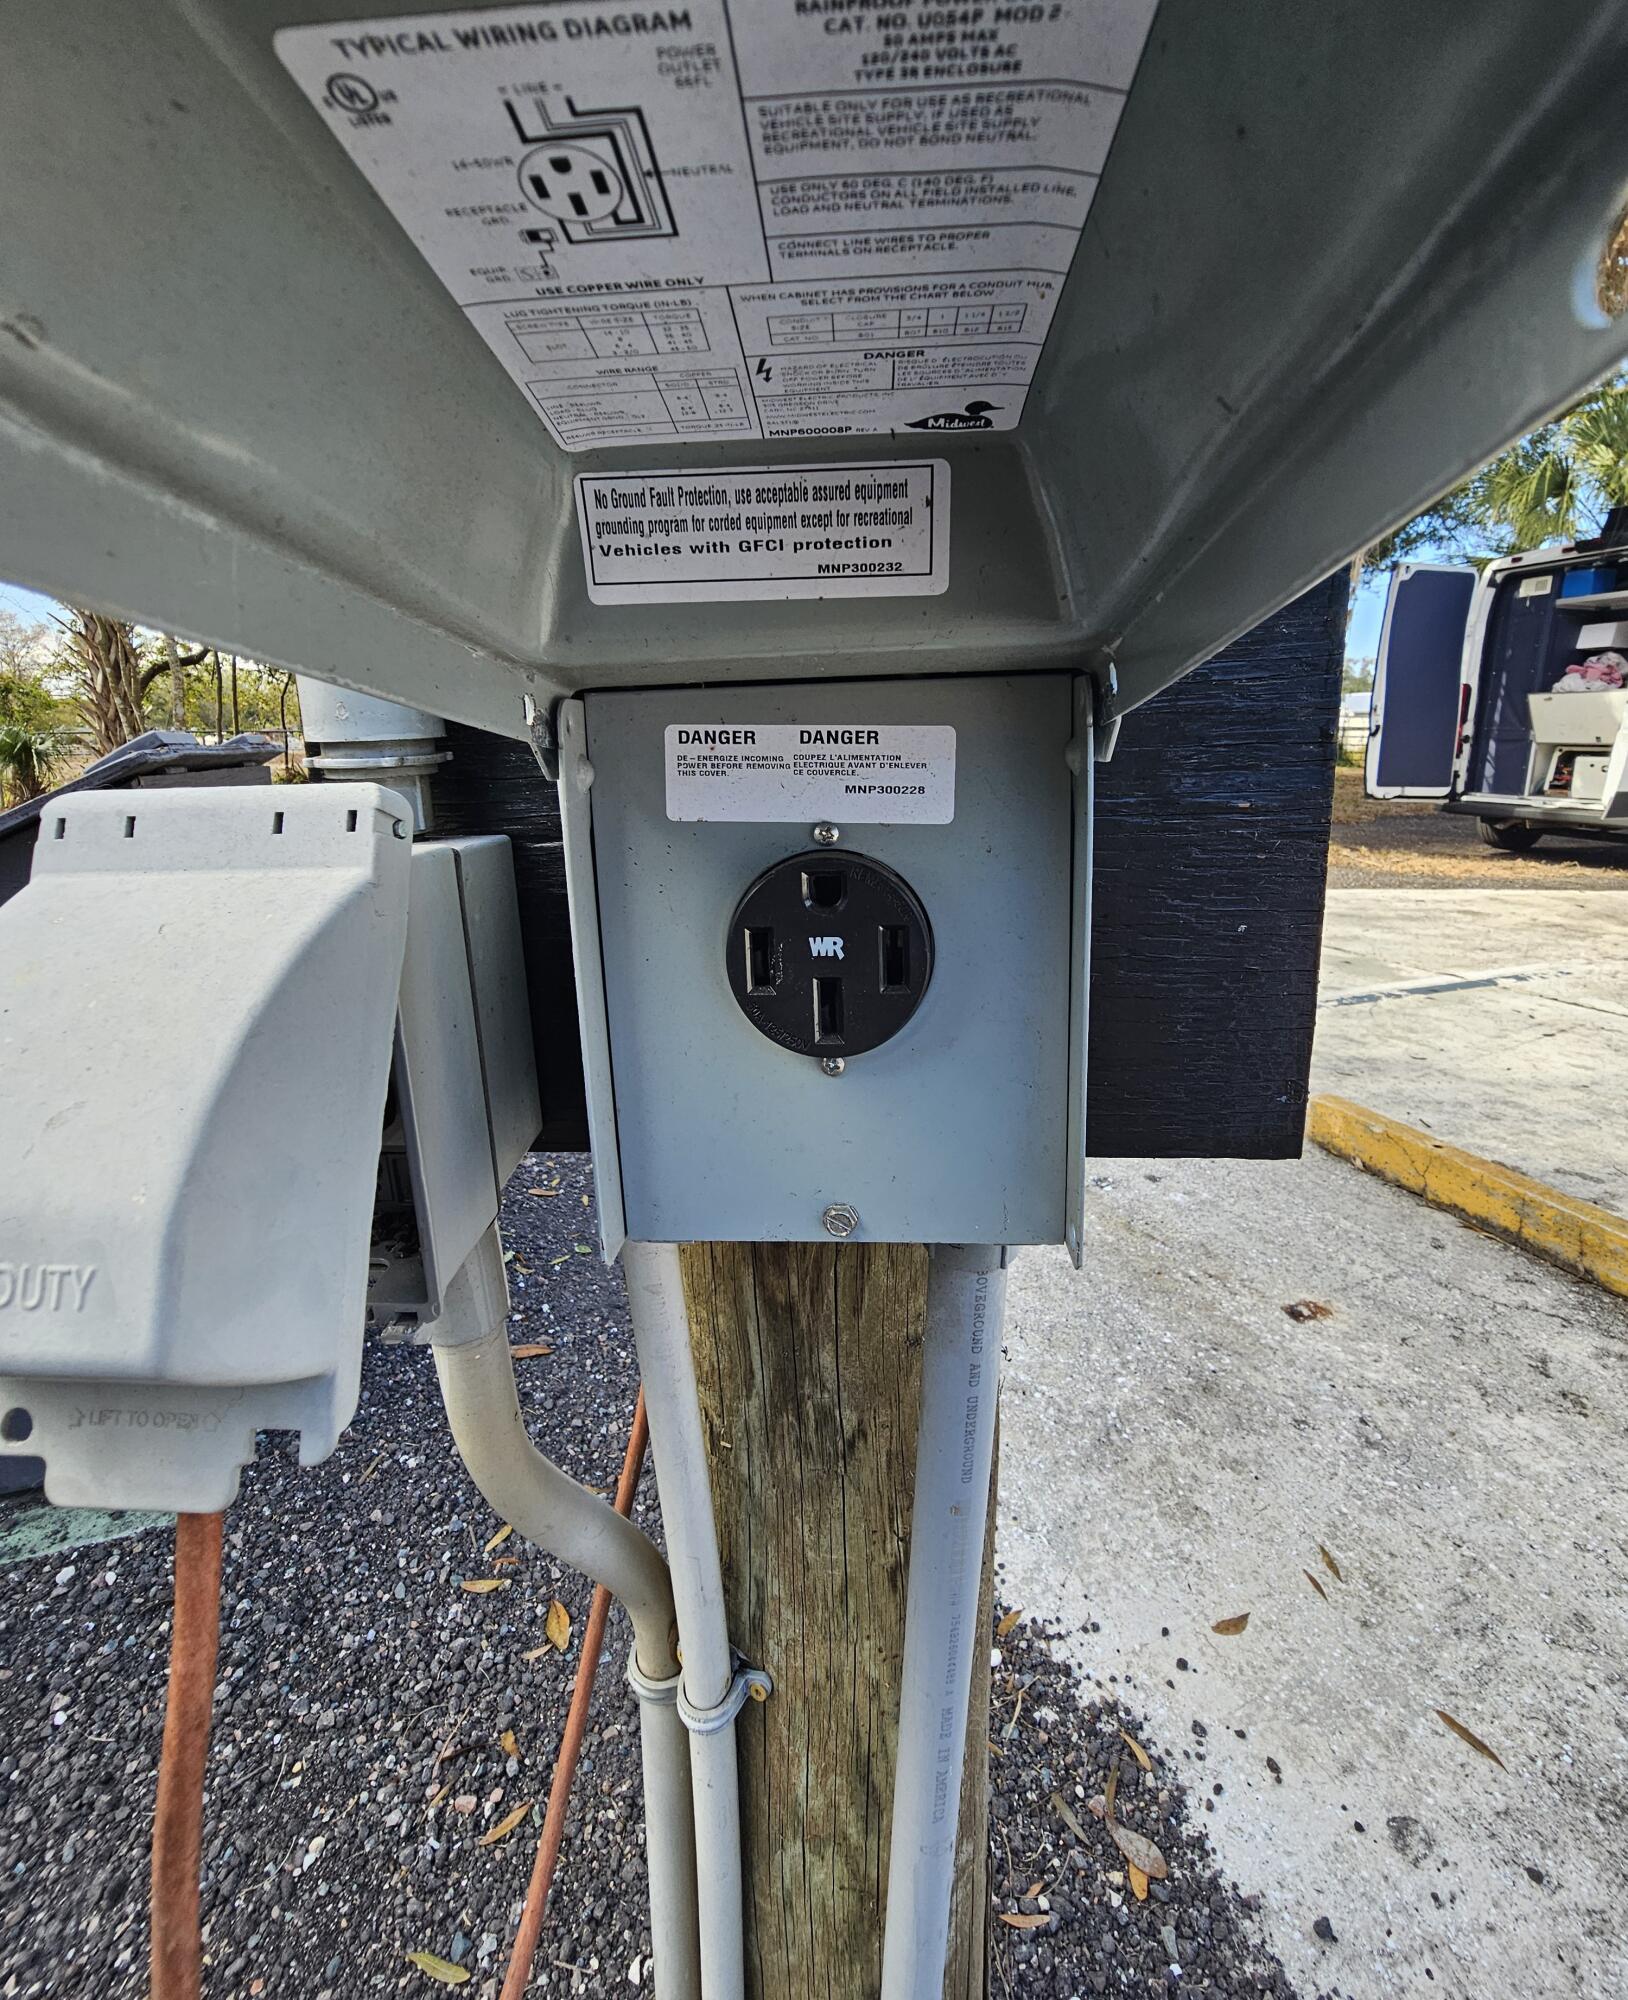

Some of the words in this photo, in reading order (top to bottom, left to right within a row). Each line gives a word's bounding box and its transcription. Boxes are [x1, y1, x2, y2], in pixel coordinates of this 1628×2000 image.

[995, 5, 1044, 24] MOD
[331, 31, 453, 60] TYPICAL
[453, 20, 557, 49] WIRING
[563, 8, 692, 40] DIAGRAM
[909, 30, 956, 45] AMPS
[962, 28, 998, 42] MAX
[657, 43, 716, 59] POWER
[936, 46, 989, 61] VOLTS
[994, 43, 1018, 57] AC
[657, 58, 721, 75] OUTLET
[855, 67, 894, 82] TYPE
[923, 60, 1022, 78] ENCLOSURE
[512, 81, 547, 96] LINE
[758, 102, 831, 117] SUITABLE
[835, 99, 878, 112] ONLY
[882, 96, 913, 109] FOR
[917, 94, 946, 107] USE
[951, 93, 971, 105] AS
[975, 88, 1091, 106] RECREATIONAL
[760, 115, 824, 130] VEHICLE
[828, 113, 860, 125] SITE
[932, 107, 944, 119] IF
[949, 106, 991, 118] USED
[995, 104, 1014, 115] AS
[763, 127, 872, 143] RECREATIONAL
[878, 121, 941, 136] VEHICLE
[945, 120, 977, 132] SITE
[982, 116, 1041, 129] SUPPLY
[858, 137, 880, 148] DO
[884, 136, 914, 147] NOT
[920, 133, 961, 146] BOND
[670, 163, 734, 177] NEUTRAL
[770, 184, 796, 195] USE
[801, 181, 838, 191] ONLY
[898, 178, 908, 187] C
[771, 189, 866, 206] CONDUCTORS
[870, 189, 892, 199] ON
[894, 188, 917, 199] ALL
[923, 184, 961, 198] FIELD
[964, 182, 1041, 195] INSTALLED
[773, 203, 808, 217] LOAD
[812, 202, 840, 212] AND
[845, 200, 904, 211] NEUTRAL
[777, 238, 839, 250] CONNECT
[843, 236, 872, 247] LINE
[874, 234, 914, 245] WIRES
[919, 233, 935, 242] TO
[939, 230, 990, 241] PROPER
[779, 247, 850, 259] TERMINALS
[852, 245, 872, 255] ON
[536, 284, 564, 296] USE
[567, 281, 623, 294] COPPER
[625, 278, 661, 289] WIRE
[665, 276, 704, 287] ONLY
[739, 292, 776, 302] WHEN
[779, 289, 829, 300] CABINET
[831, 288, 855, 297] HAS
[859, 284, 929, 295] PROVISIONS
[933, 282, 956, 291] FOR
[968, 280, 1023, 290] CONDUIT
[801, 297, 842, 306] SELECT
[848, 295, 884, 303] FROM
[887, 293, 907, 301] THE
[909, 291, 949, 300] CHART
[952, 289, 995, 298] BELOW
[504, 309, 528, 318] LUG
[530, 304, 600, 316] TIGHTENING
[602, 301, 651, 311] TORQUE
[864, 350, 925, 360] DANGER
[624, 365, 659, 373] RANGE
[769, 426, 852, 437] MNP600008P
[594, 488, 608, 509] No
[611, 487, 646, 509] Ground
[650, 486, 675, 508] Fault
[678, 484, 731, 508] Protection,
[735, 488, 752, 504] use
[755, 481, 809, 507] acceptable
[812, 480, 850, 502] assured
[855, 478, 908, 504] equipment
[595, 517, 645, 539] grounding
[648, 517, 688, 537] program
[691, 514, 705, 532] for
[708, 513, 742, 532] corded
[745, 511, 797, 533] equipment
[801, 510, 833, 531] except
[836, 509, 850, 527] for
[853, 506, 913, 526] recreational
[599, 543, 682, 557] Vehicles
[689, 541, 730, 554] with
[738, 539, 784, 552] GFCI
[793, 536, 892, 553] protection
[817, 562, 903, 574] MNP300232
[678, 730, 756, 745] DANGER
[800, 730, 879, 745] DANGER
[845, 785, 926, 794] MNP300228
[809, 936, 845, 960] WR
[968, 1363, 982, 1388] AND
[88, 1411, 121, 1427] LIFT
[127, 1411, 150, 1428] TO
[152, 1411, 199, 1429] OPEN
[960, 1395, 979, 1485] UNDERGROUND
[939, 1705, 955, 1740] MADE
[937, 1745, 951, 1764] IN
[932, 1770, 949, 1825] AMERICA
